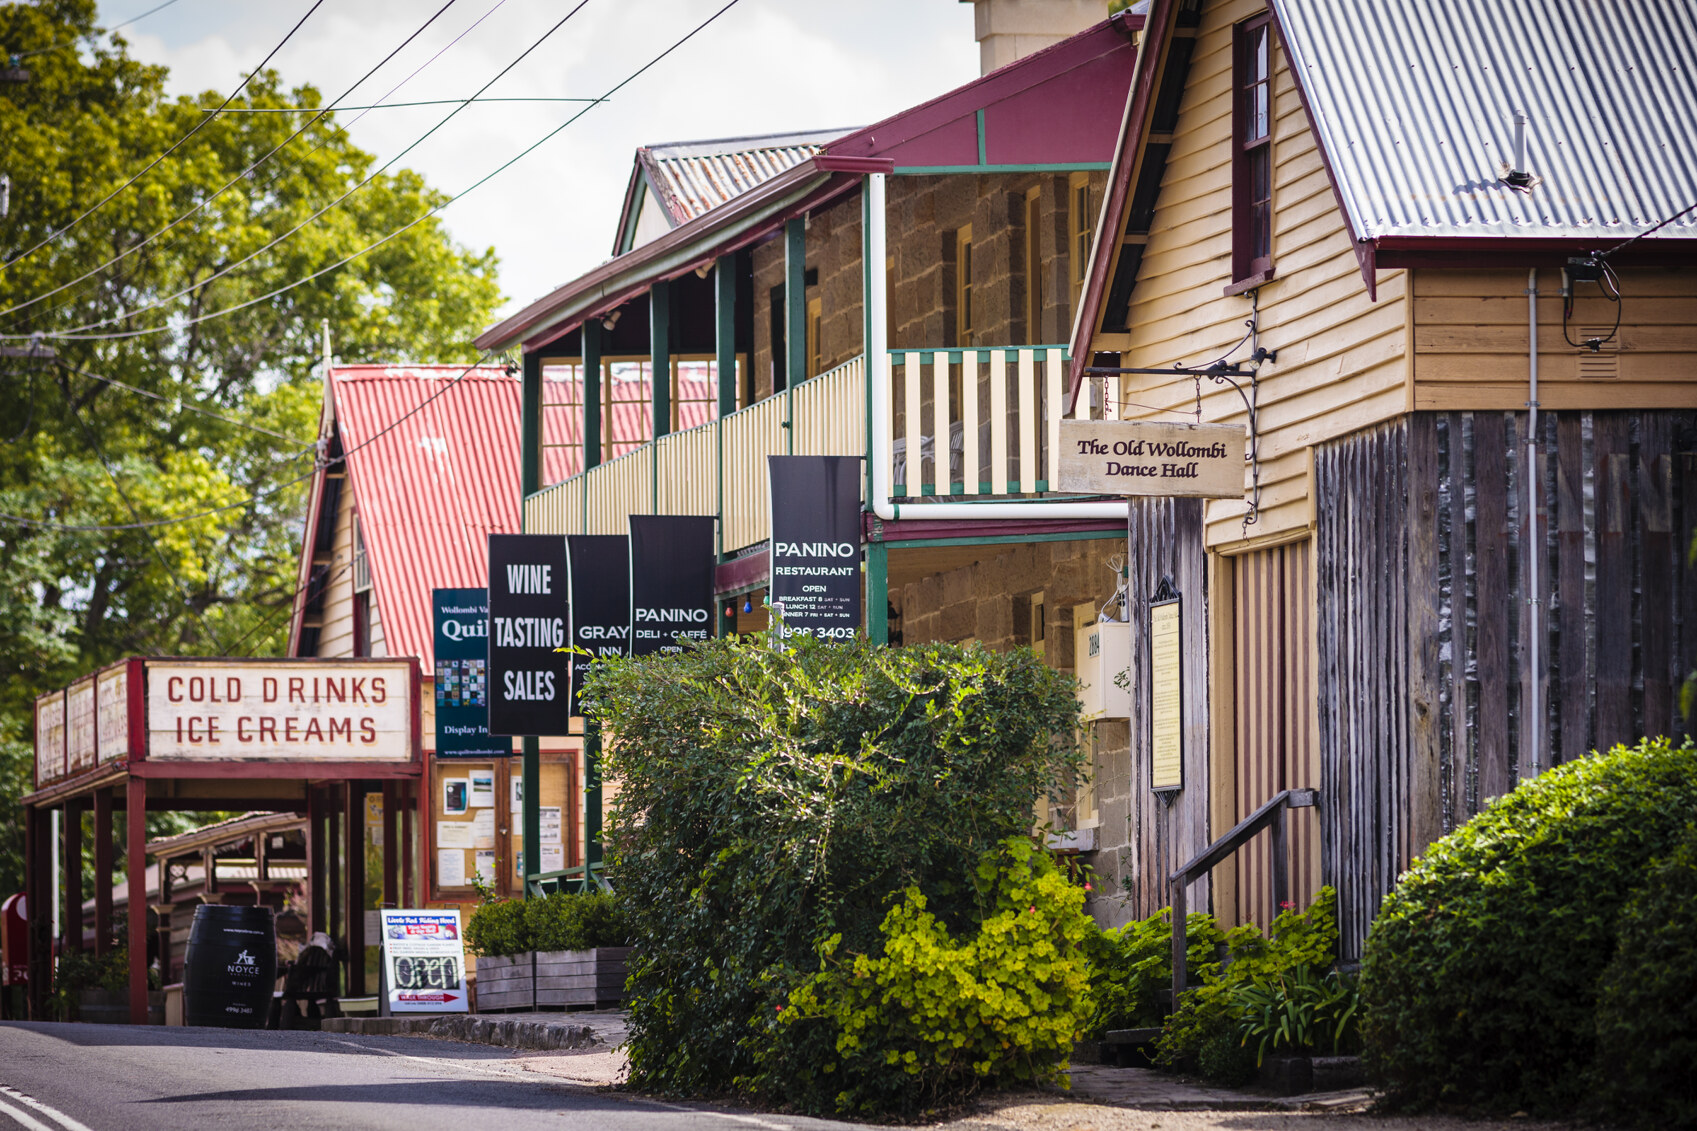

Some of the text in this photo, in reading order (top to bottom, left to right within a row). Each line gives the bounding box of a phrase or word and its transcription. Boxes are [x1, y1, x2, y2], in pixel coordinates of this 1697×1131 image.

[1077, 439, 1227, 460] The Old Wollombi
[1105, 461, 1199, 479] Dance Hall
[775, 542, 854, 558] PANINO
[775, 566, 854, 576] RESTAURANT
[506, 564, 552, 595] WINE
[801, 585, 827, 593] OPEN
[441, 605, 478, 614] Wollombi
[635, 608, 708, 623] PANINO
[494, 616, 564, 649] TASTING
[579, 625, 630, 640] GRAY
[636, 629, 661, 639] DELI
[670, 628, 708, 639] CAFFÉ
[816, 627, 855, 639] 3403
[598, 646, 622, 657] INN
[660, 645, 683, 653] OPEN
[168, 676, 387, 704] COLD DRINKS
[503, 670, 556, 702] SALES
[175, 716, 377, 744] ICE CREAMS
[443, 725, 477, 736] Display
[405, 917, 418, 925] Red
[227, 964, 260, 975] NOYCE
